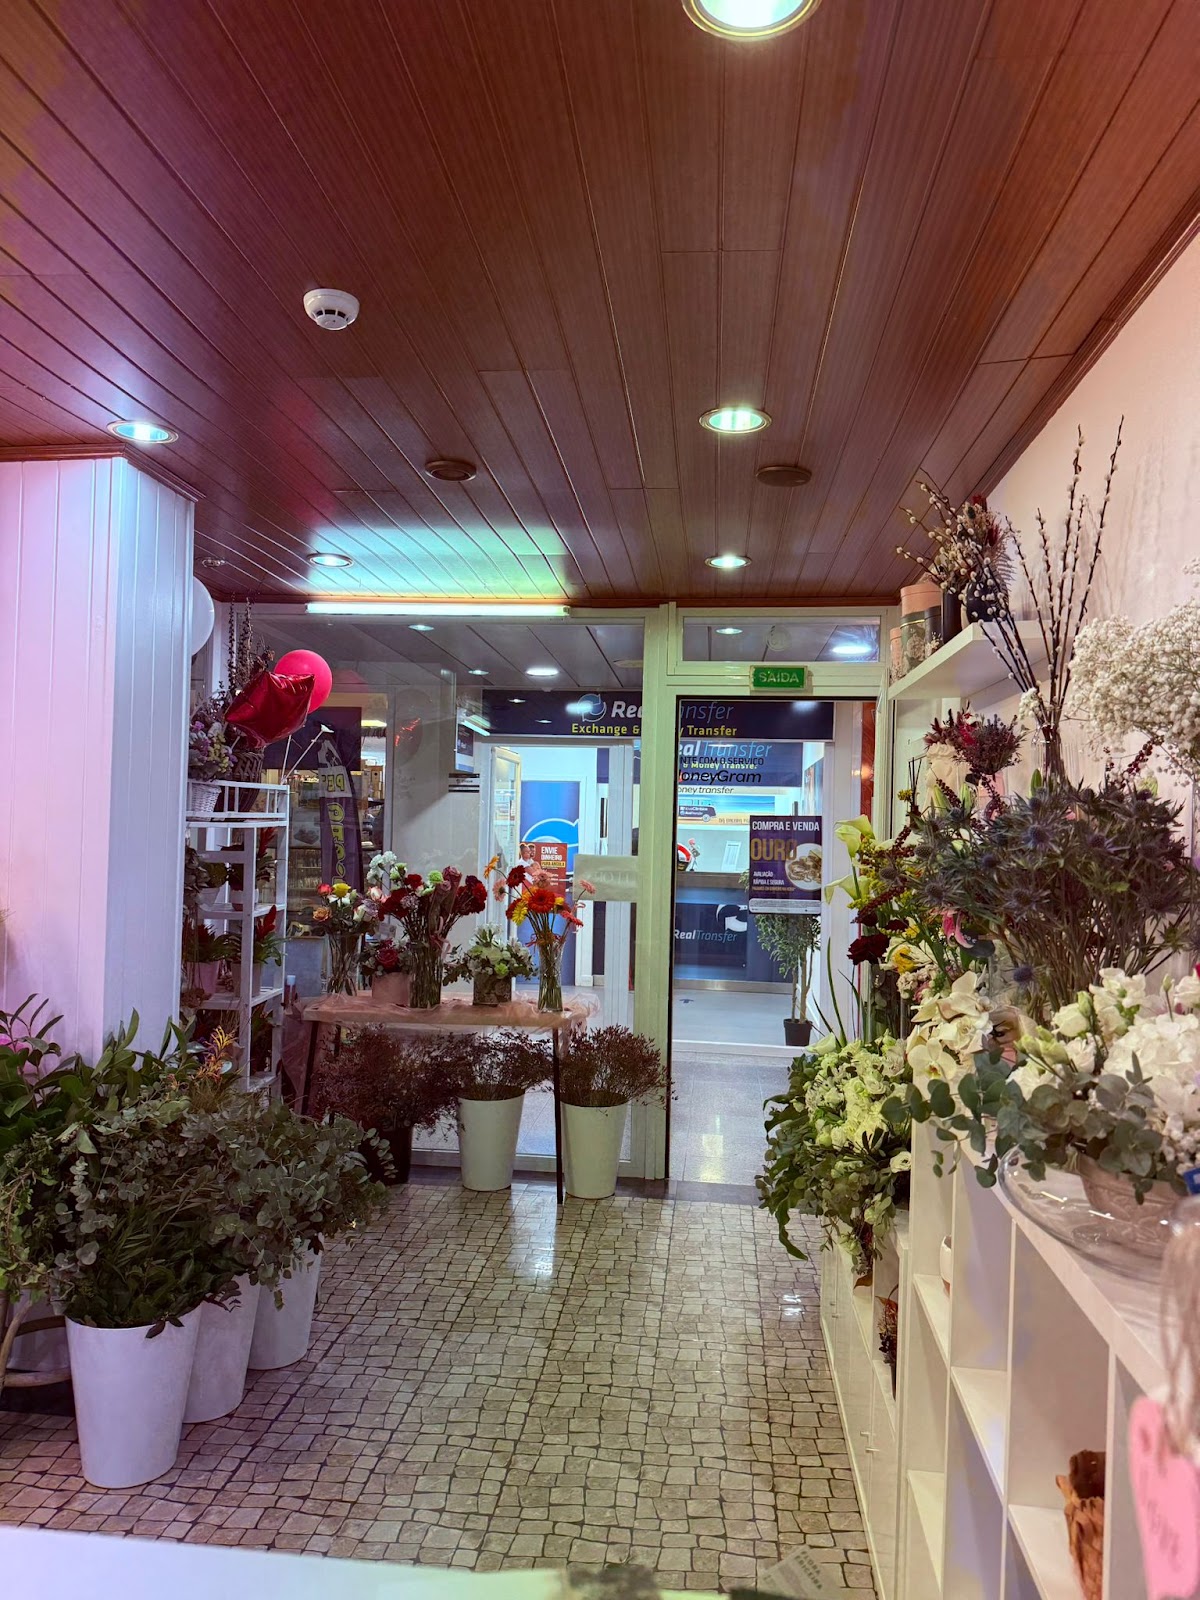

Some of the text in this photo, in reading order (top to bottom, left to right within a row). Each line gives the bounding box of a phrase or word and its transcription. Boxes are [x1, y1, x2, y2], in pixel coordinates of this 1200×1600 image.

[571, 723, 628, 736] Exchange
[687, 725, 738, 736] Transfer
[699, 757, 717, 765] COM
[679, 770, 762, 785] oneyGram
[698, 786, 734, 794] transfer
[752, 821, 820, 831] COMPRA E VENDA
[541, 846, 558, 855] ENVIE
[750, 838, 797, 861] OURO
